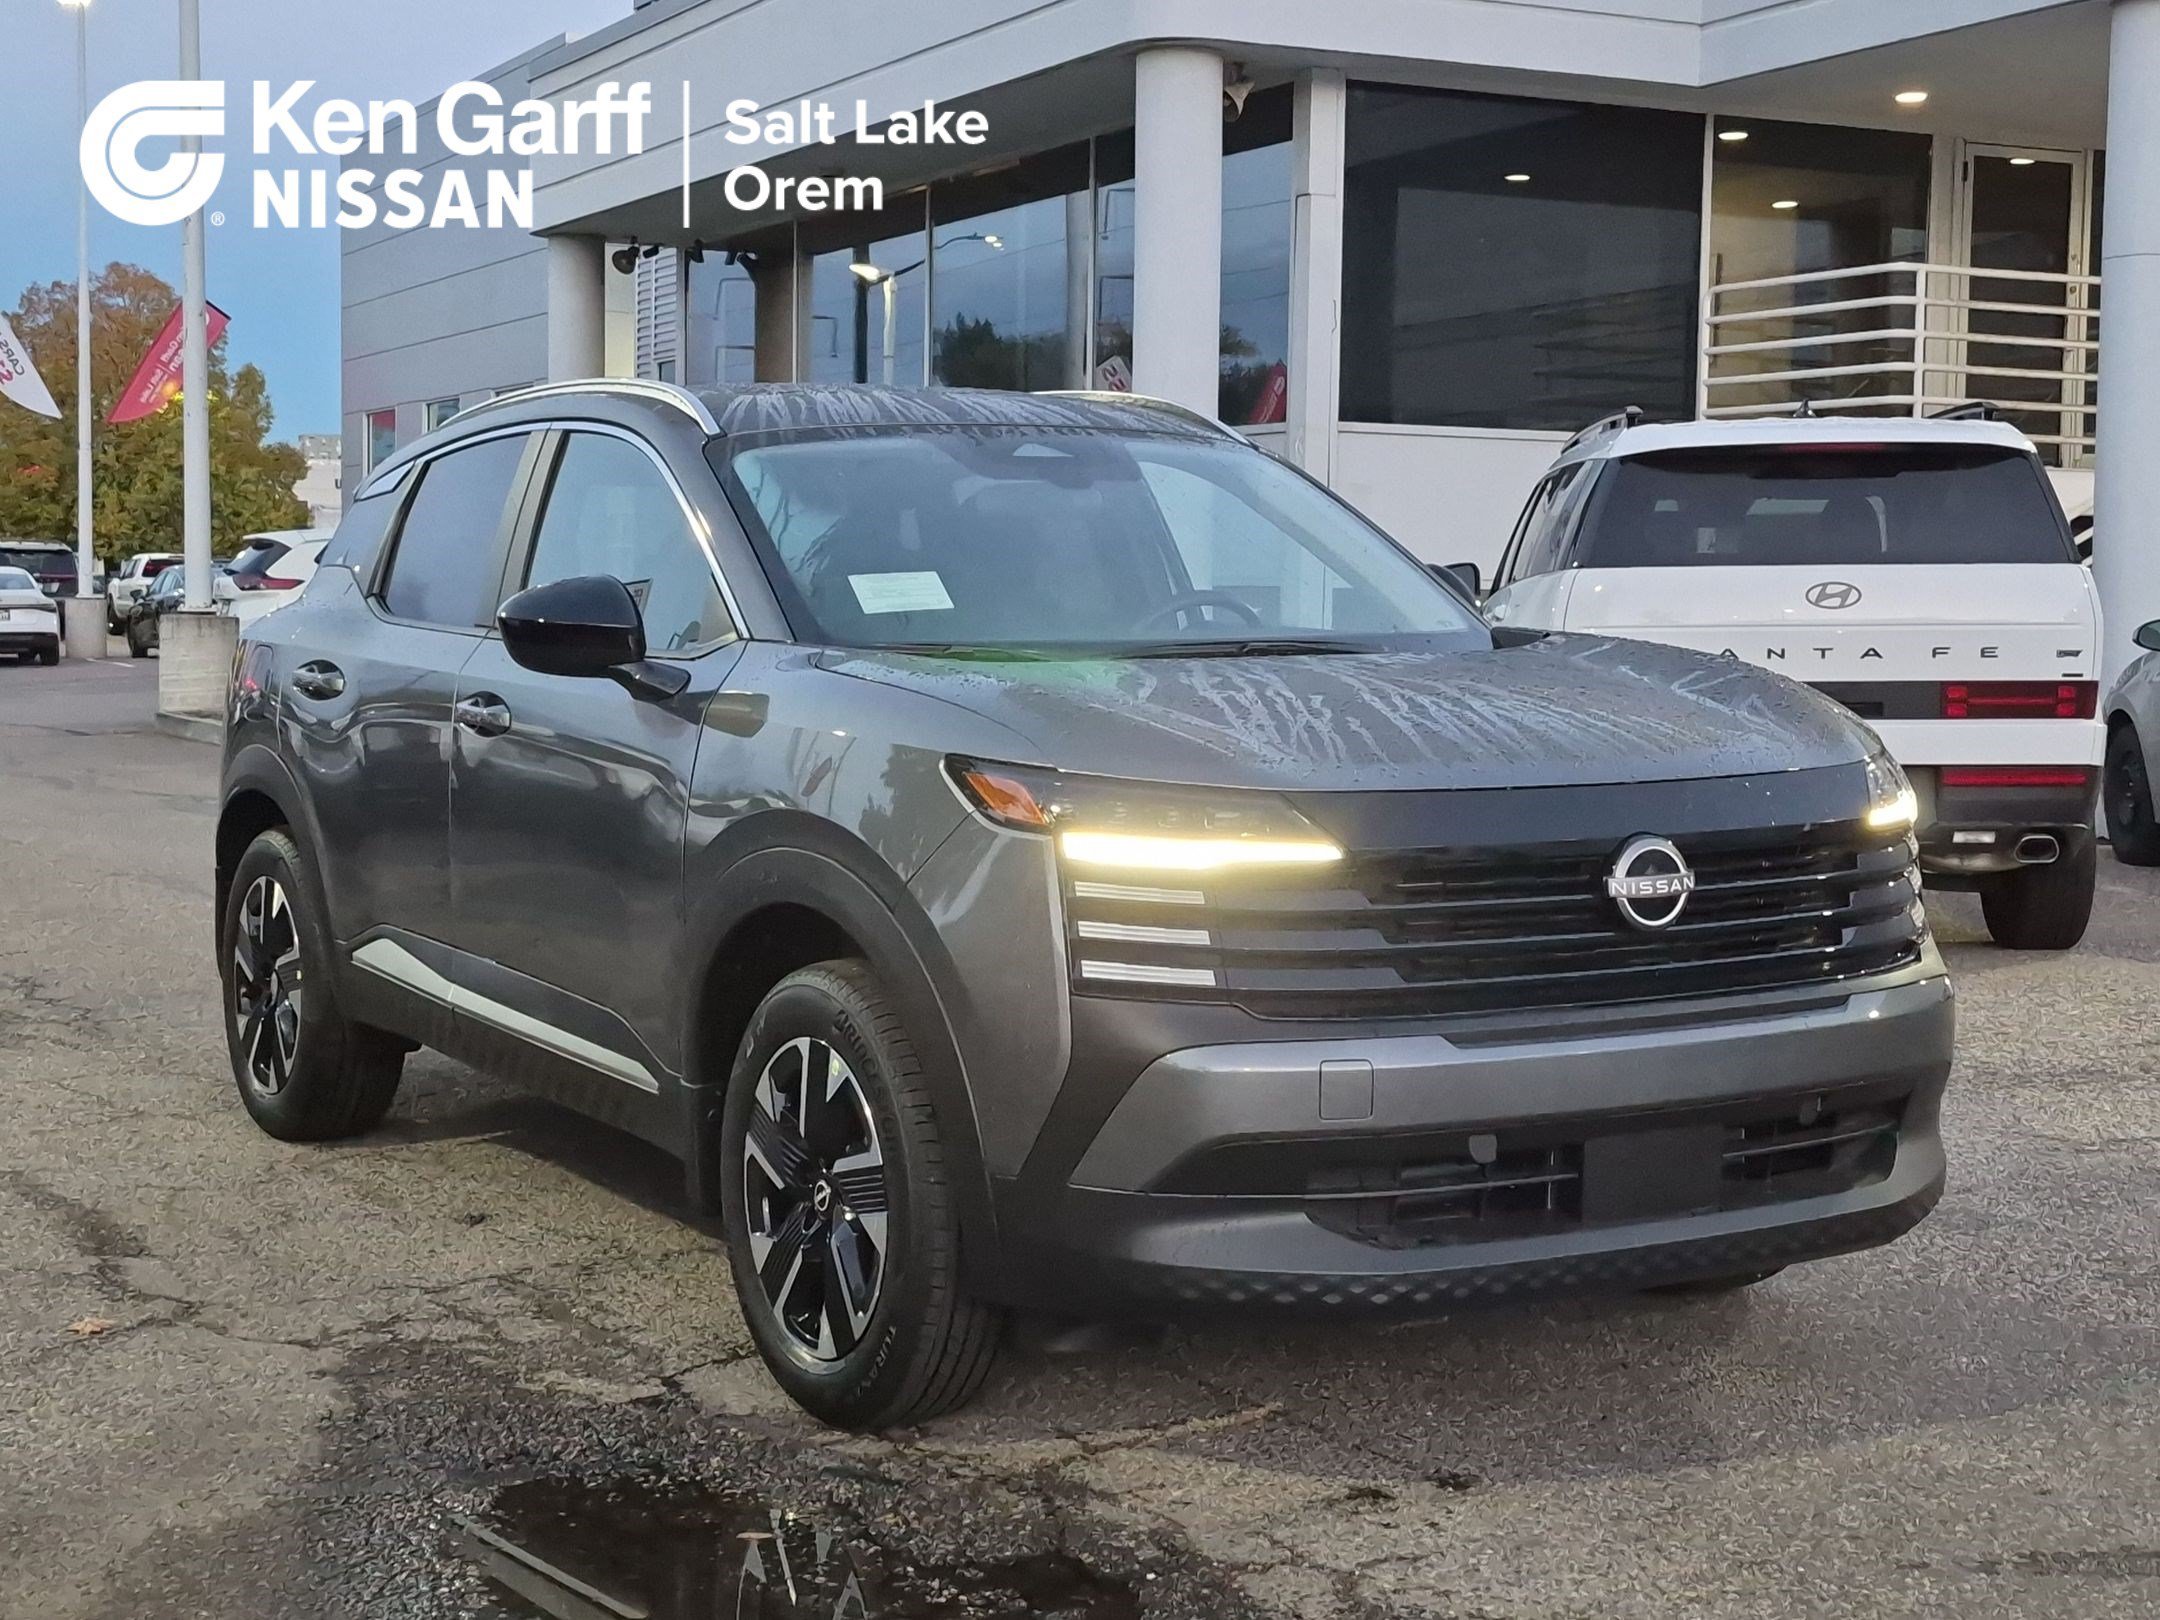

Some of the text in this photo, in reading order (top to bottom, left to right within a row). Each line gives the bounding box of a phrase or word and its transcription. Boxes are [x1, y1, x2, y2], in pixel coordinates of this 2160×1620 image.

[1720, 646, 1999, 659] ANTA FE
[1611, 876, 1695, 896] NISSAN
